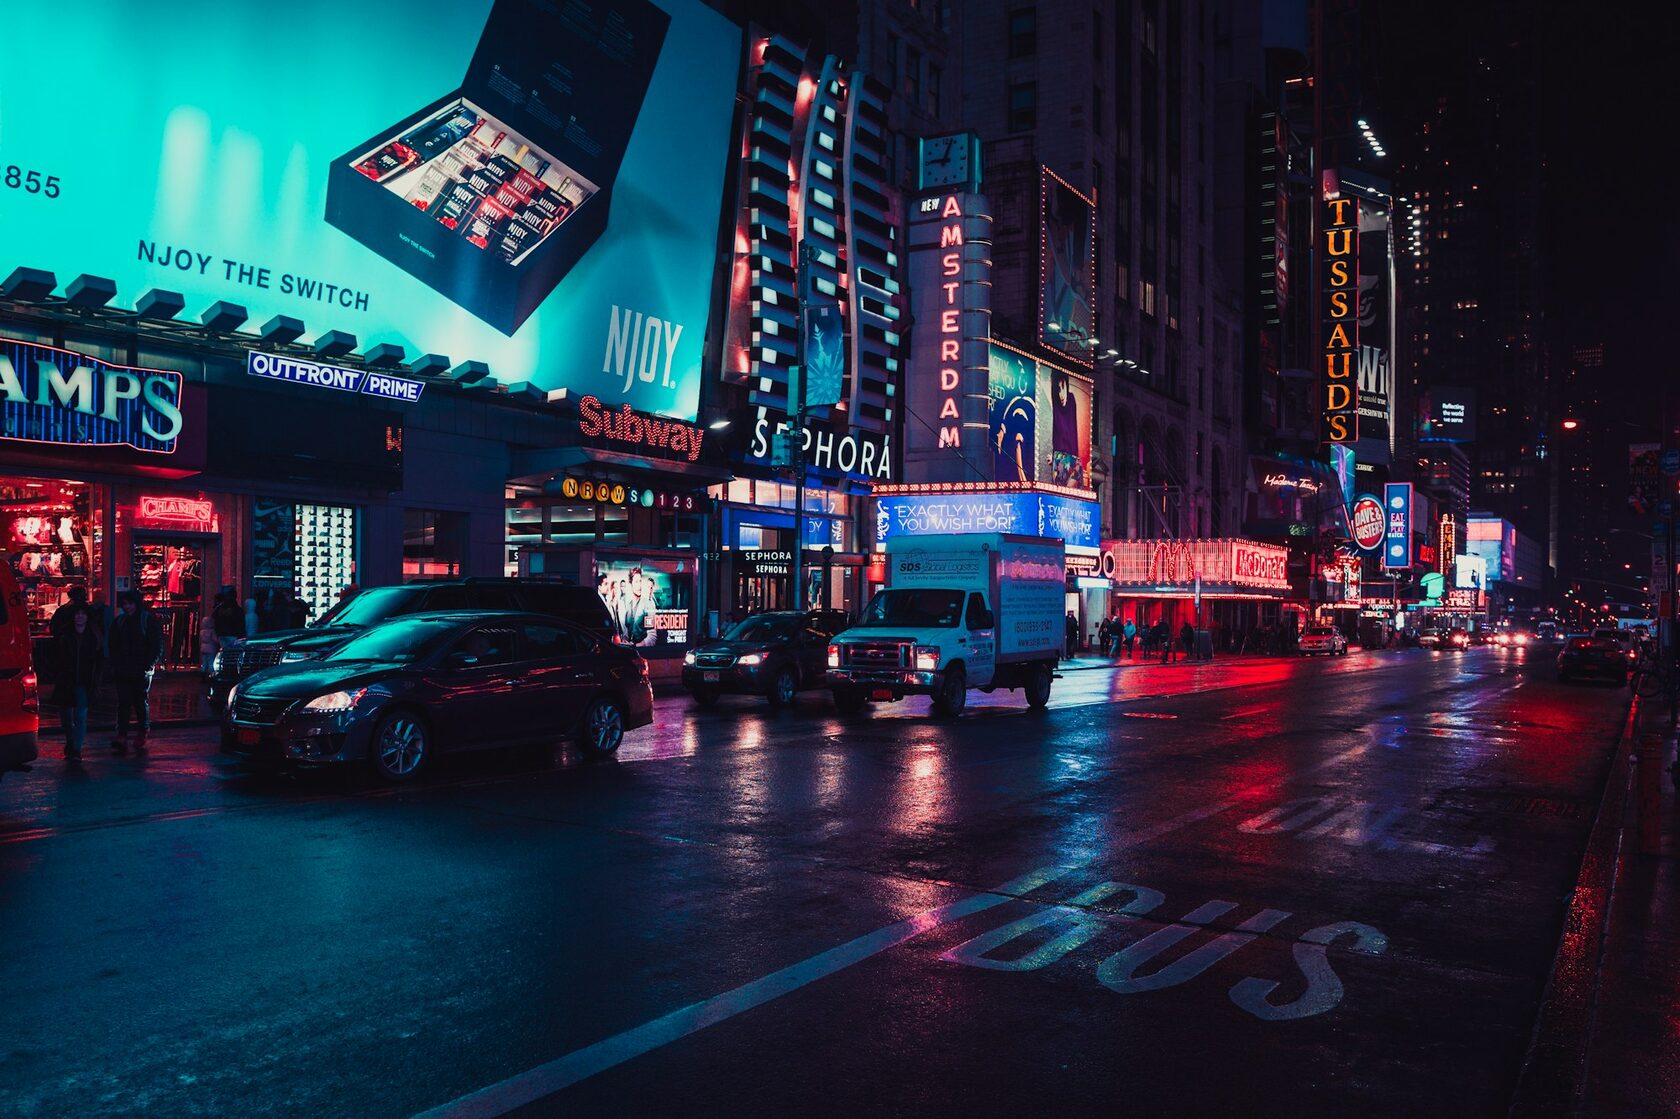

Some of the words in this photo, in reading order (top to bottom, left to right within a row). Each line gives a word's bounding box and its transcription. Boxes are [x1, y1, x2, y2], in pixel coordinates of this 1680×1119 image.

[0, 165, 61, 199] 855
[469, 174, 489, 192] NJOY
[453, 185, 474, 203] NJOY
[496, 190, 518, 208] NJOY
[481, 202, 502, 220] NJOY
[921, 198, 939, 212] NEW
[508, 222, 528, 239] NJOY
[138, 239, 212, 275] NJOY
[223, 259, 271, 290] THE
[280, 273, 370, 312] SWITCH
[940, 196, 962, 448] AMSTERDAM
[1326, 199, 1350, 440] TUSSAUD'S
[252, 354, 359, 391] OUTFRONT
[369, 373, 420, 400] PRIME
[579, 395, 705, 462] Subway
[568, 481, 576, 492] N
[584, 483, 592, 494] R
[600, 485, 609, 497] Q
[615, 486, 623, 498] W
[630, 489, 638, 503] S
[659, 493, 665, 506] 1
[673, 495, 680, 508] 2
[686, 497, 693, 509] 3
[143, 499, 210, 521] CHAMPS
[966, 503, 1014, 517] WHAT
[1355, 507, 1375, 525] DAVE
[1374, 506, 1381, 520] &
[899, 518, 930, 532] YOU
[933, 517, 972, 531] WISH
[745, 551, 792, 561] SEPHORA
[755, 564, 788, 574] SEPHORA
[899, 562, 921, 572] SDS
[655, 614, 688, 629] RESIDENT
[939, 880, 1390, 1021] BUS
